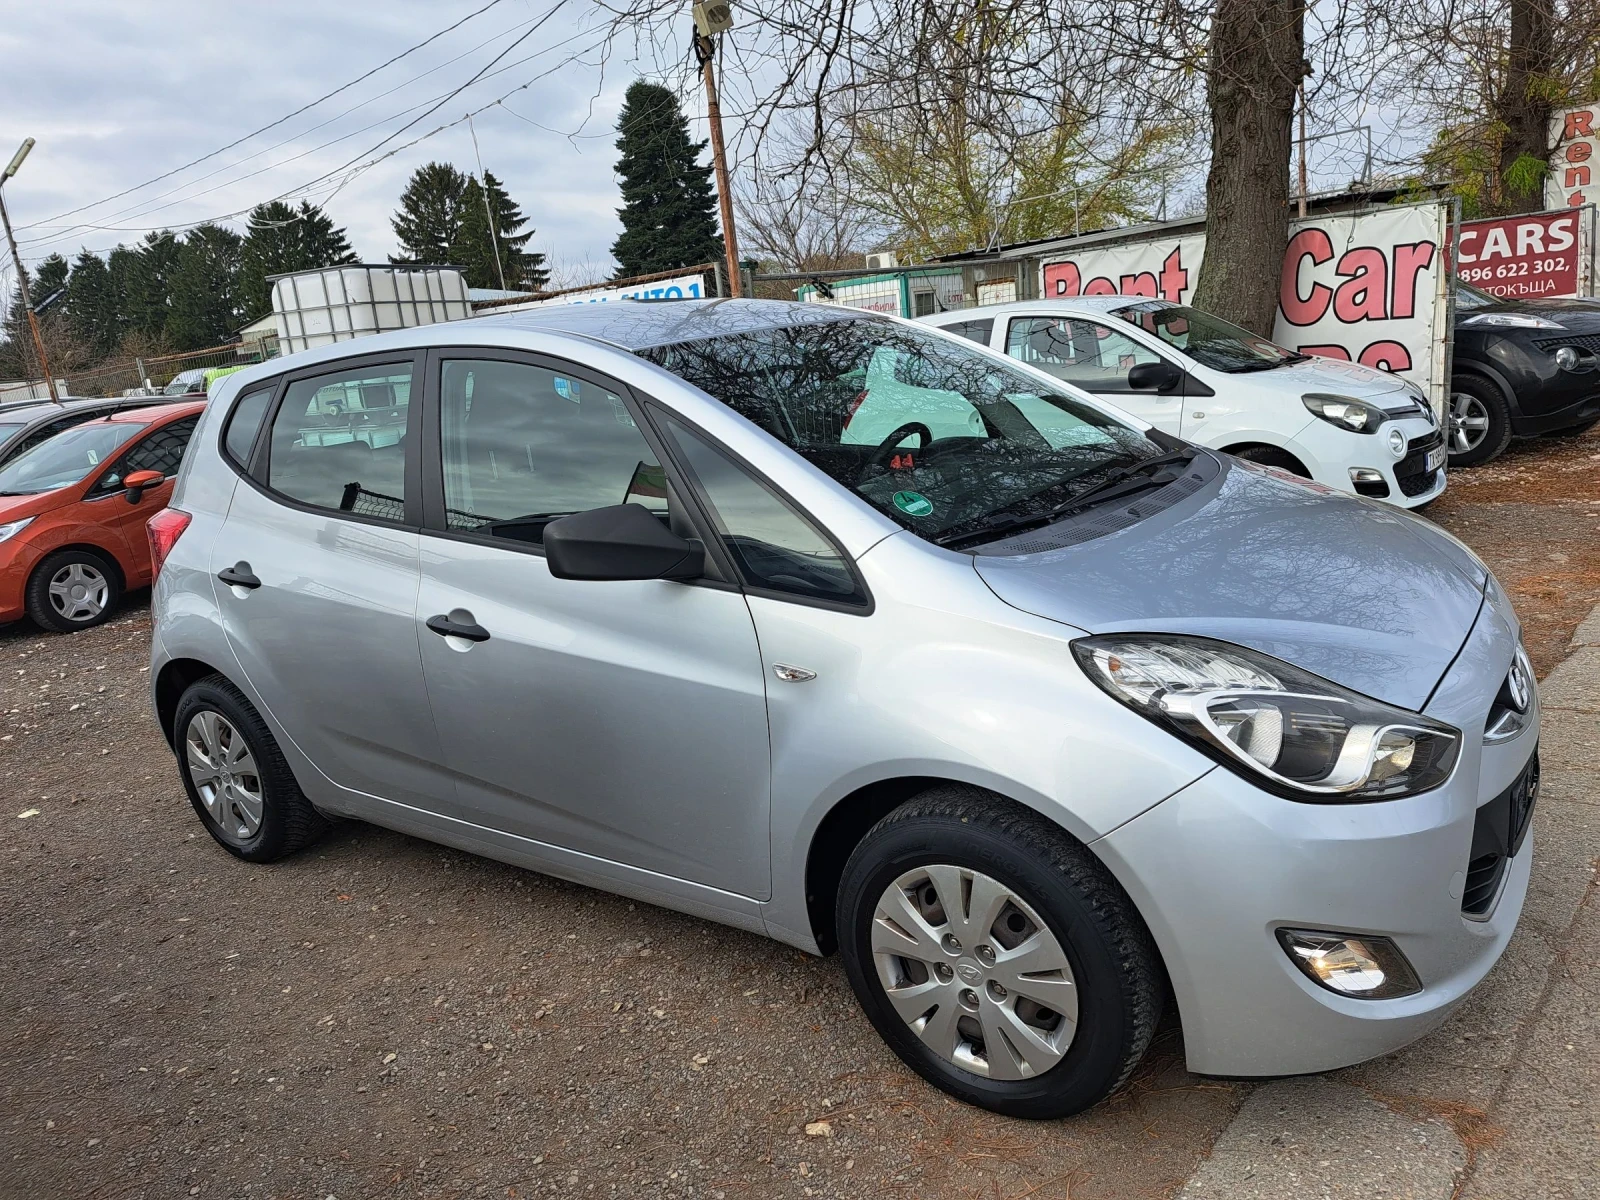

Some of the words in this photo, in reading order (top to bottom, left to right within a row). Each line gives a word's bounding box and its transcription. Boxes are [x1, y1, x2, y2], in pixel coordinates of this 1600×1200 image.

[1565, 110, 1595, 207] Rent
[1450, 219, 1574, 263] CARS
[1279, 227, 1436, 327] Car
[1457, 267, 1492, 282] 896
[1496, 262, 1528, 279] 622
[1533, 257, 1570, 275] 302,
[621, 286, 683, 300] TO
[1481, 279, 1556, 297] ТОКЪЩА
